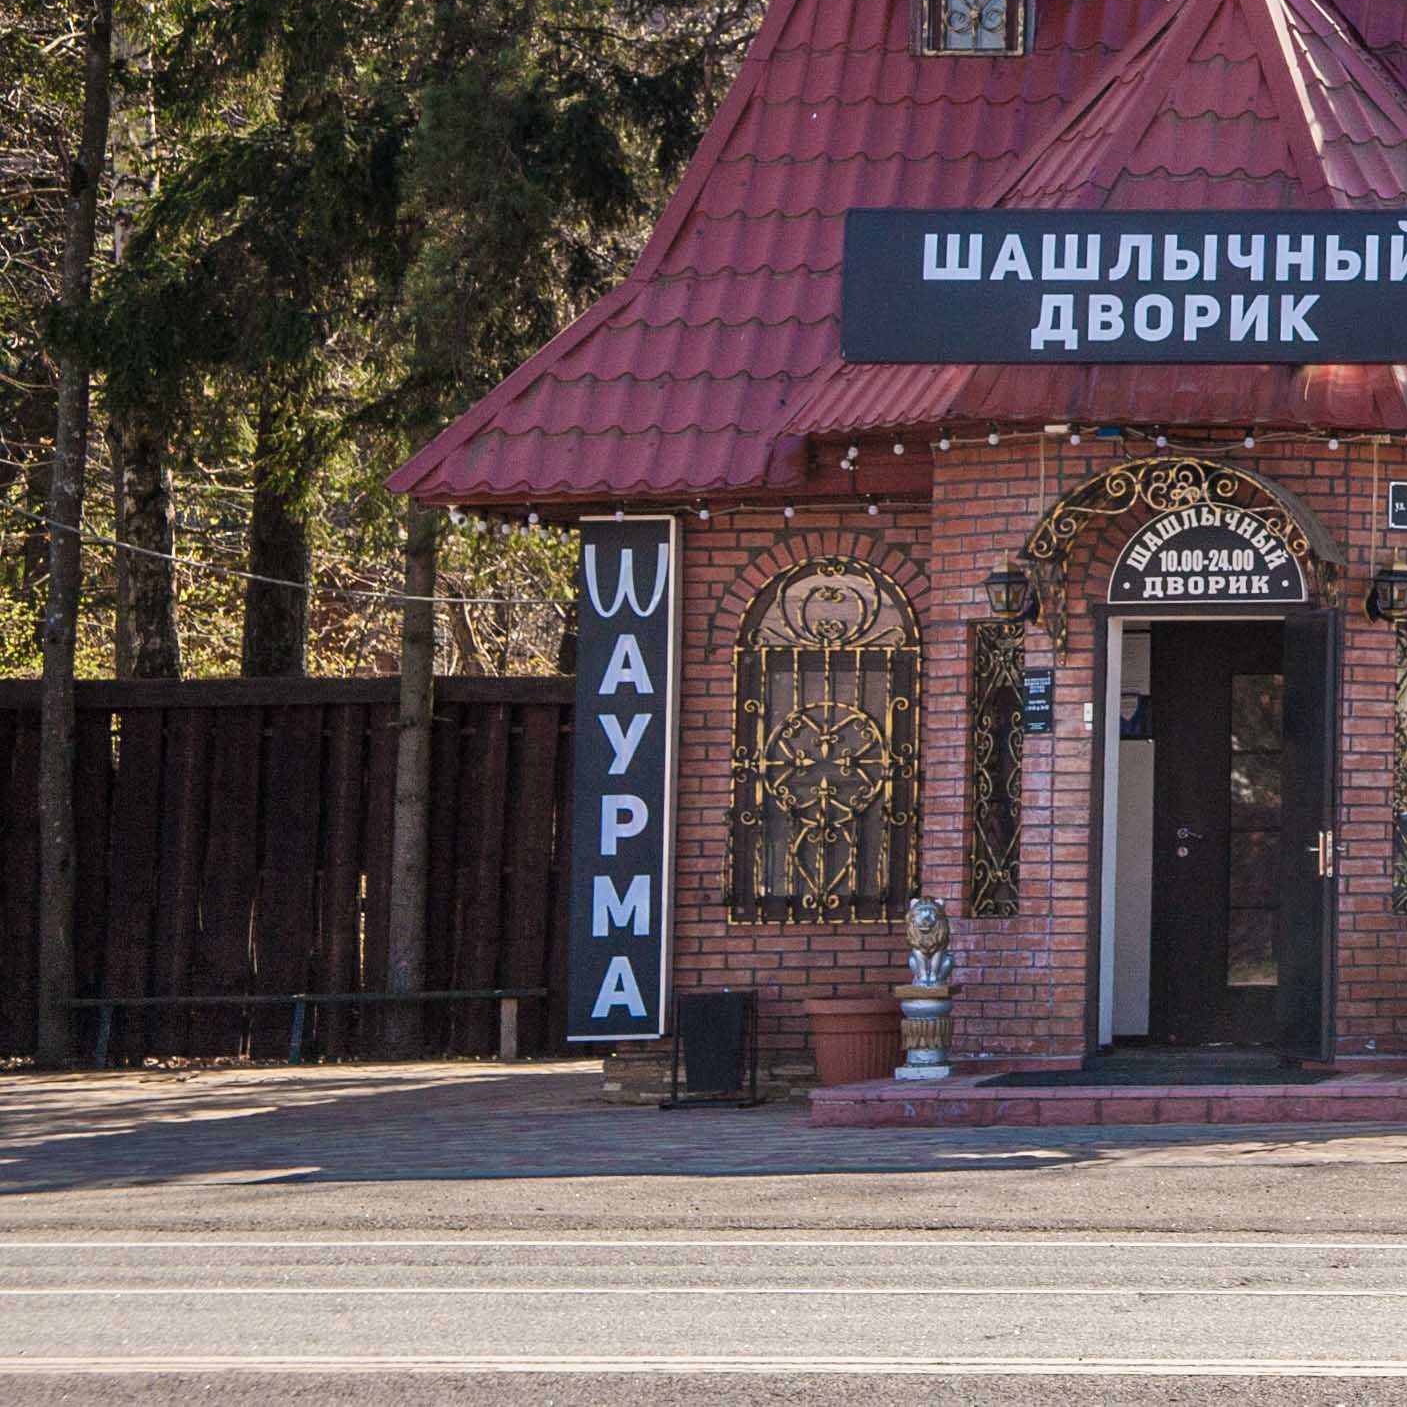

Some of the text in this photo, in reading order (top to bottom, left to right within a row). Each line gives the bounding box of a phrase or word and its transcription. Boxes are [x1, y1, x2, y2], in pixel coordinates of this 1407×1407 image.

[1030, 294, 1321, 350] ДВОРИК
[1126, 507, 1288, 572] ШАШЛЫЧНЫЙ
[1158, 549, 1254, 572] 10.00-24.00
[1143, 575, 1270, 598] ДВОРИК
